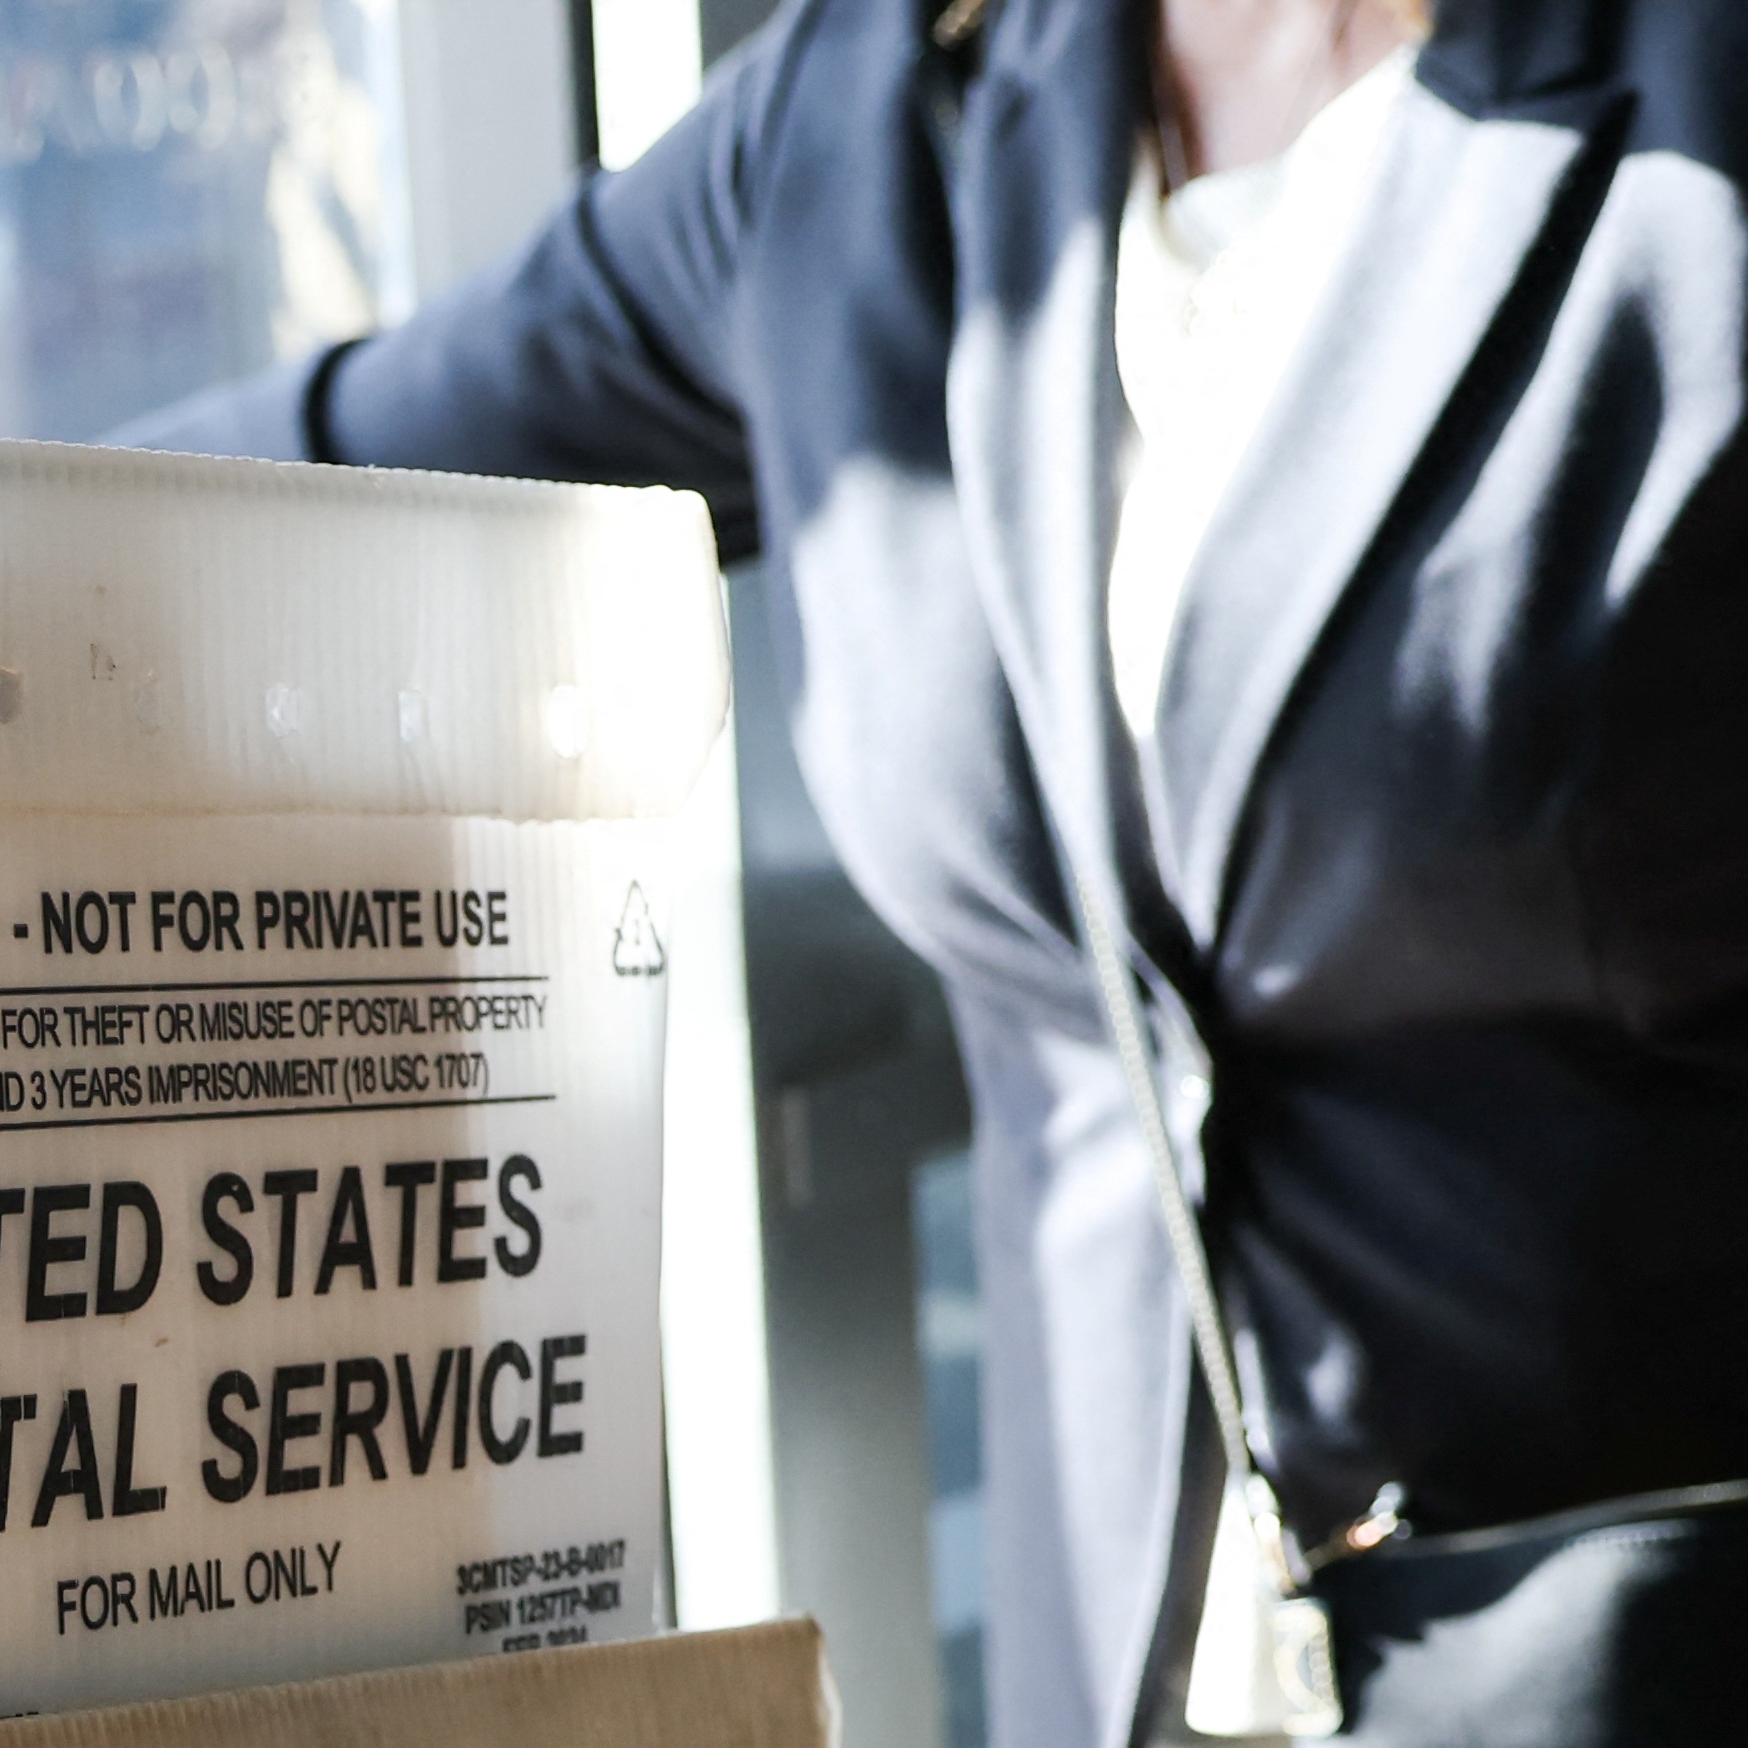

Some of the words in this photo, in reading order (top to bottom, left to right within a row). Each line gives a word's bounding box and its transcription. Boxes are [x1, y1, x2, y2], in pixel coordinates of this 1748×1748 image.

[41, 891, 136, 954] NOT
[152, 890, 244, 952] FOR
[255, 890, 423, 950] PRIVATE
[436, 890, 509, 947] USE
[2, 1006, 61, 1049] FOR
[63, 1004, 150, 1047] THEFT
[155, 1003, 197, 1044] OR
[200, 1000, 295, 1042] MISUSE
[299, 998, 333, 1038] OF
[338, 996, 428, 1036] POSTAL
[430, 994, 548, 1034] PROPERTY
[31, 1070, 47, 1110] 3
[50, 1065, 143, 1109] YEARS
[151, 1057, 339, 1103] IMPRISONMENT
[343, 1055, 376, 1104] (18
[381, 1054, 429, 1093] USC
[434, 1052, 490, 1097] 1707)
[195, 1153, 543, 1306] STATES
[201, 1334, 587, 1505] SERVICE
[57, 1578, 139, 1636] FOR
[149, 1558, 235, 1621] MAIL
[245, 1540, 342, 1604] ONLY
